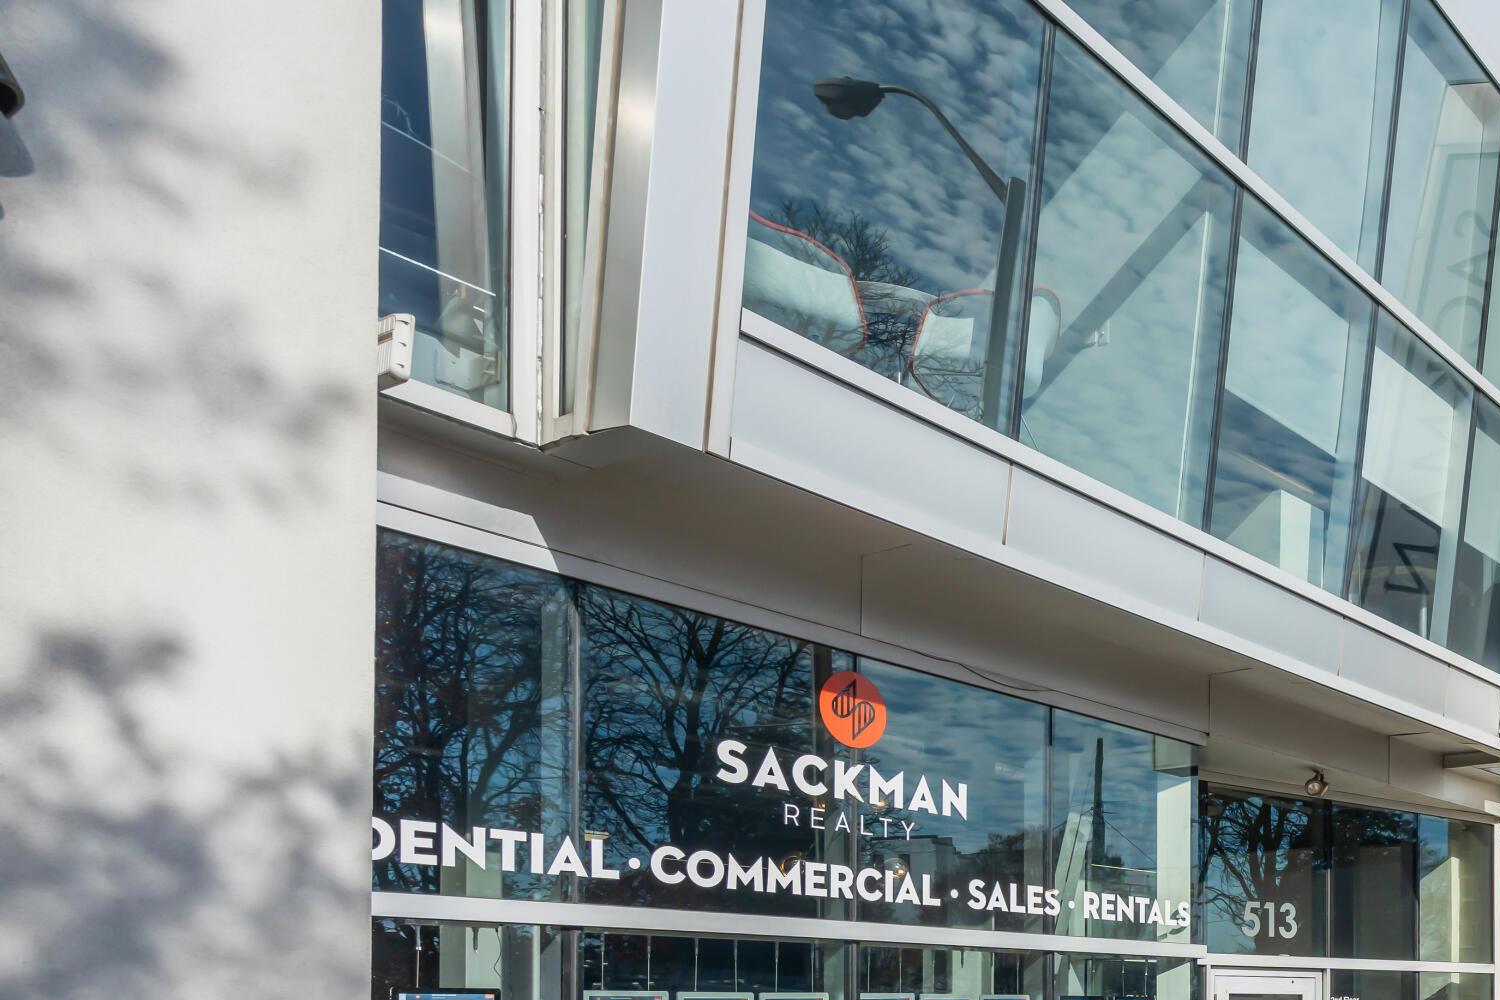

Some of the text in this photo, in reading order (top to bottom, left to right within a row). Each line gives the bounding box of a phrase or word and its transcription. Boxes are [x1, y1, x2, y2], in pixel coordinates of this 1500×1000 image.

[716, 739, 968, 821] SACKMAN
[783, 803, 917, 841] REALTY
[650, 845, 941, 906] COMMERCIAL
[967, 879, 1060, 916] SALES
[1083, 891, 1191, 927] RENTALS
[1242, 901, 1298, 940] 513
